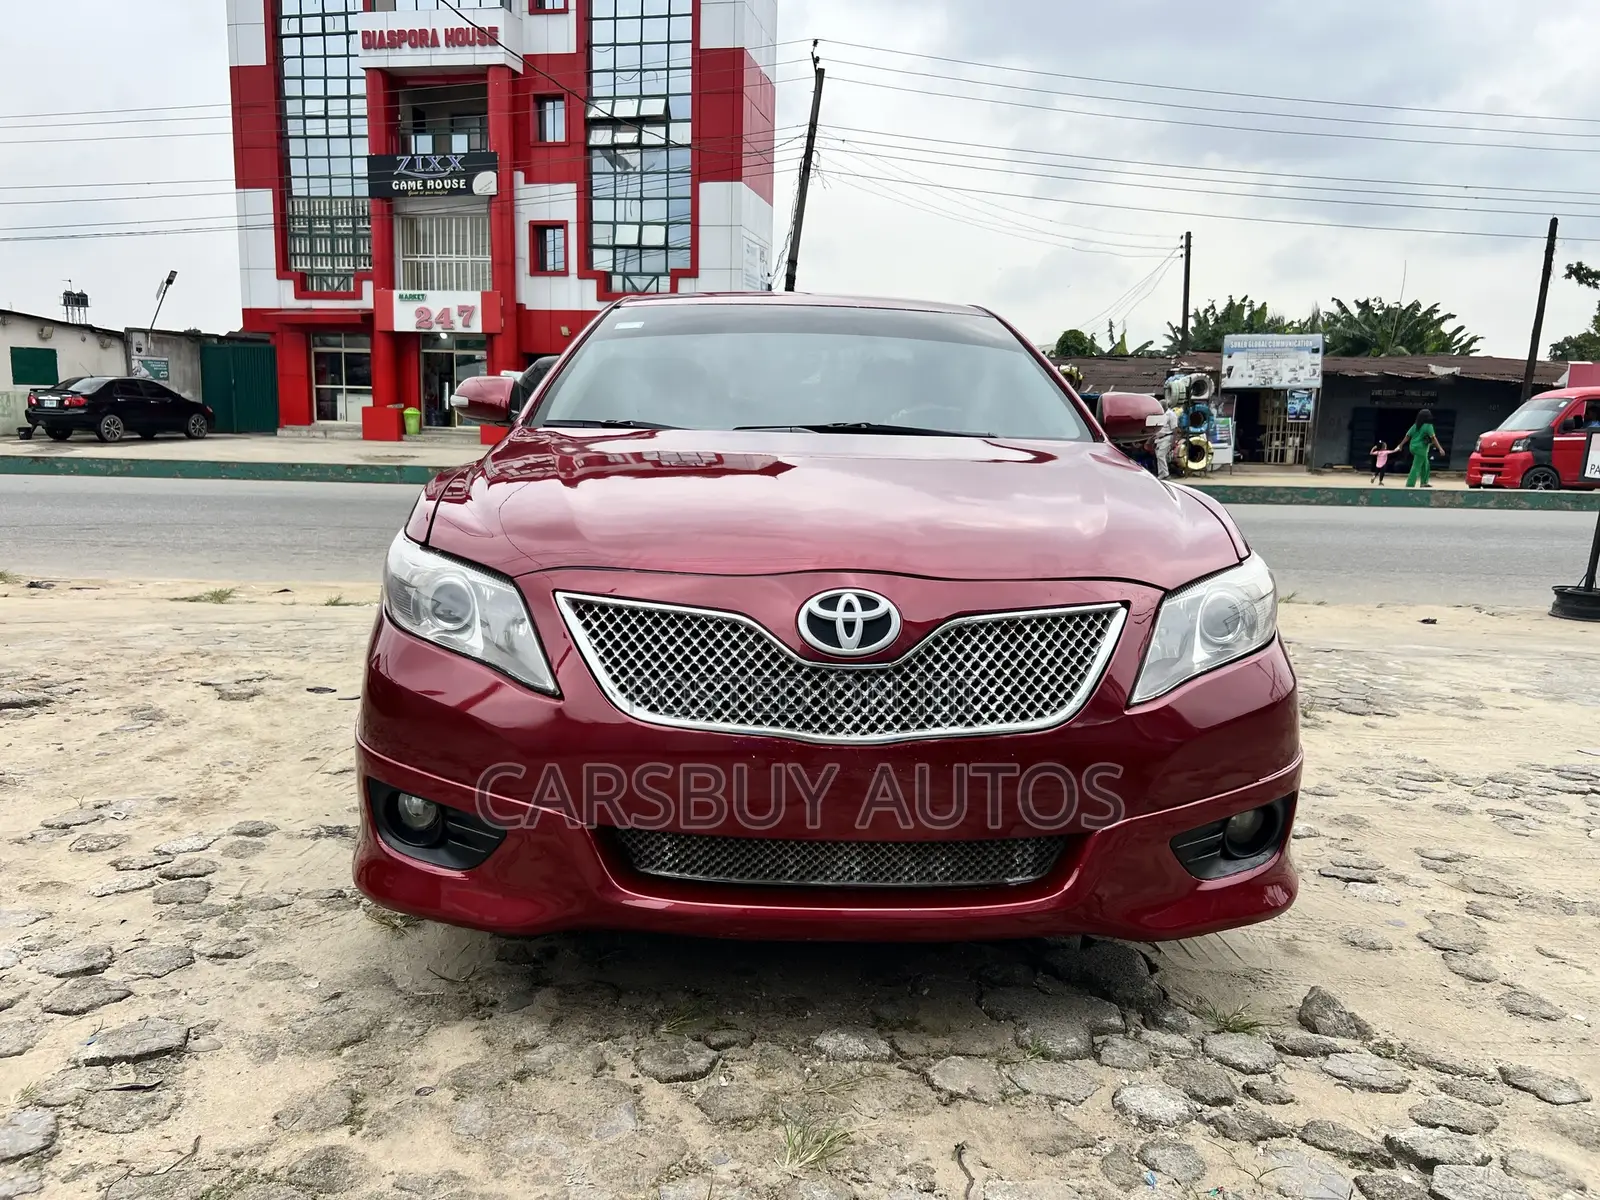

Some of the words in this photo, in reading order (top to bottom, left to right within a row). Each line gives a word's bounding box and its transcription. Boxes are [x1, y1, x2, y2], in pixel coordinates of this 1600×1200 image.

[361, 28, 441, 50] DIASPORA
[444, 26, 499, 48] HOUSE
[394, 155, 466, 175] ZIXX
[392, 180, 424, 190] GAME
[427, 179, 467, 190] HOUSE
[398, 293, 427, 301] MARKET
[415, 305, 476, 330] 247
[1248, 340, 1268, 348] GLOBAL
[1268, 339, 1313, 348] COMMUNICATION
